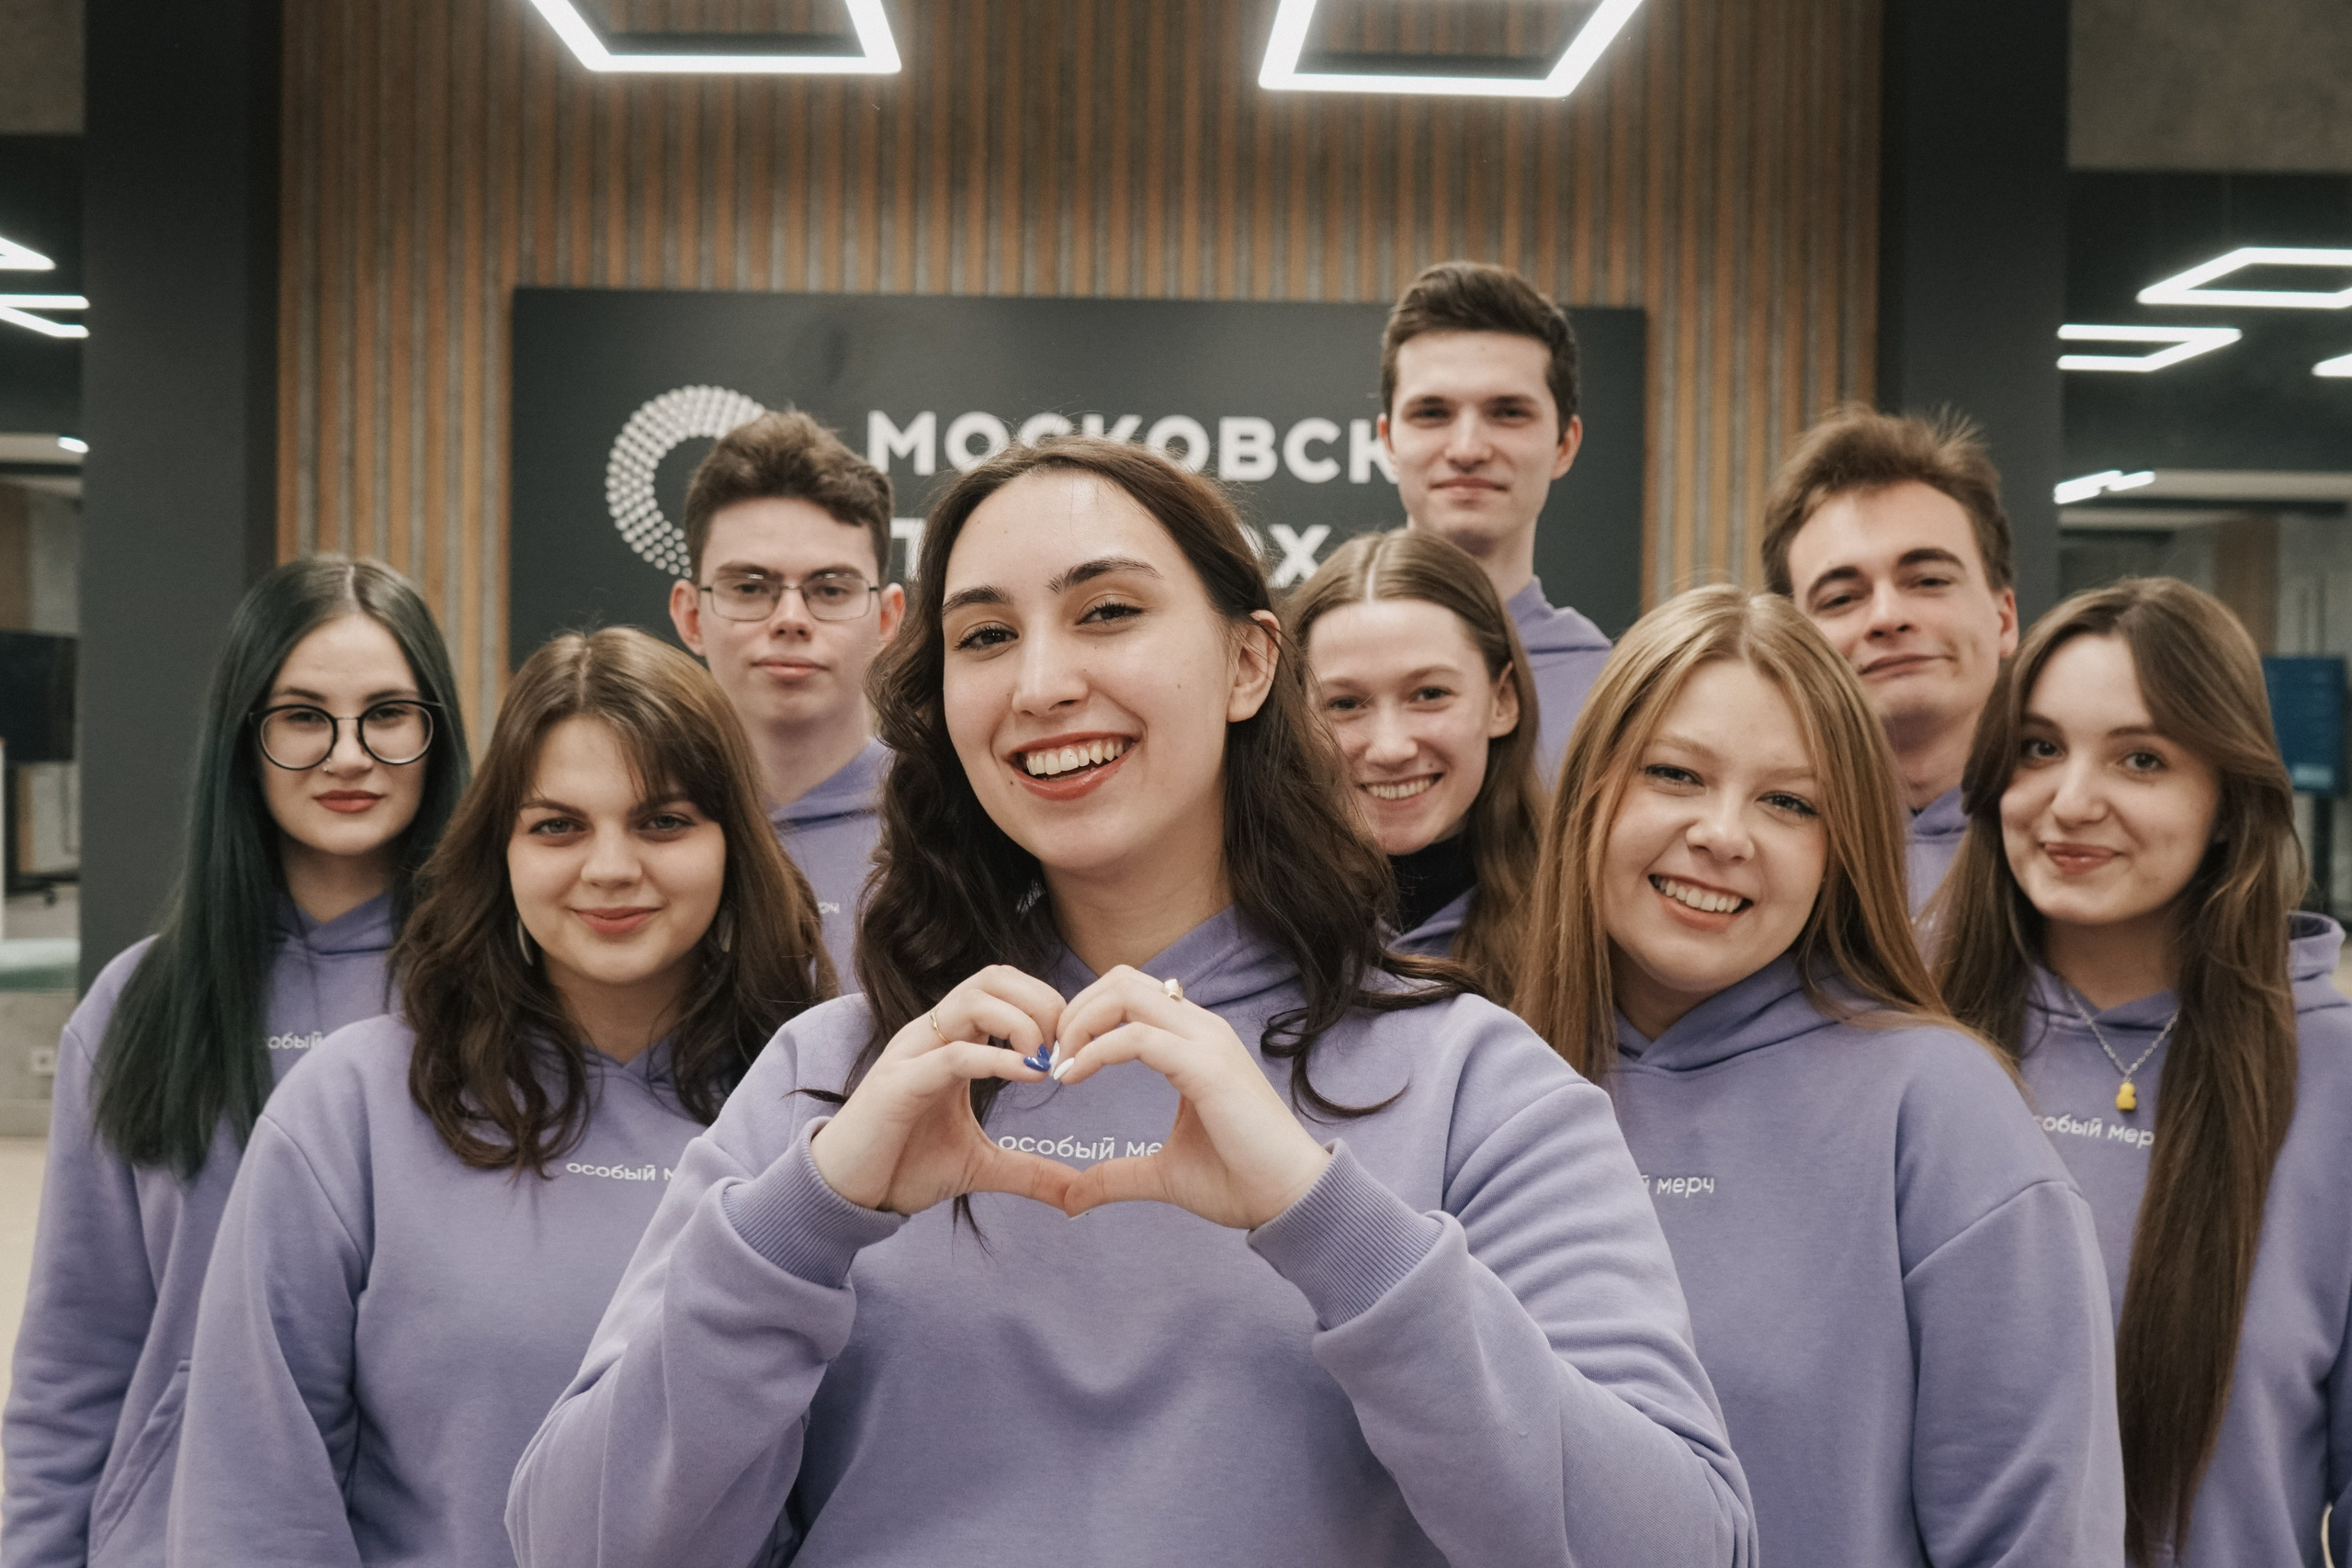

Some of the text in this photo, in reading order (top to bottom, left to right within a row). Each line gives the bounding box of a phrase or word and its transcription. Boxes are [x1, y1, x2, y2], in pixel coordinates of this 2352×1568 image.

[999, 1135, 1115, 1160] особый
[566, 1162, 656, 1181] особый
[1657, 1176, 1715, 1199] мерч
